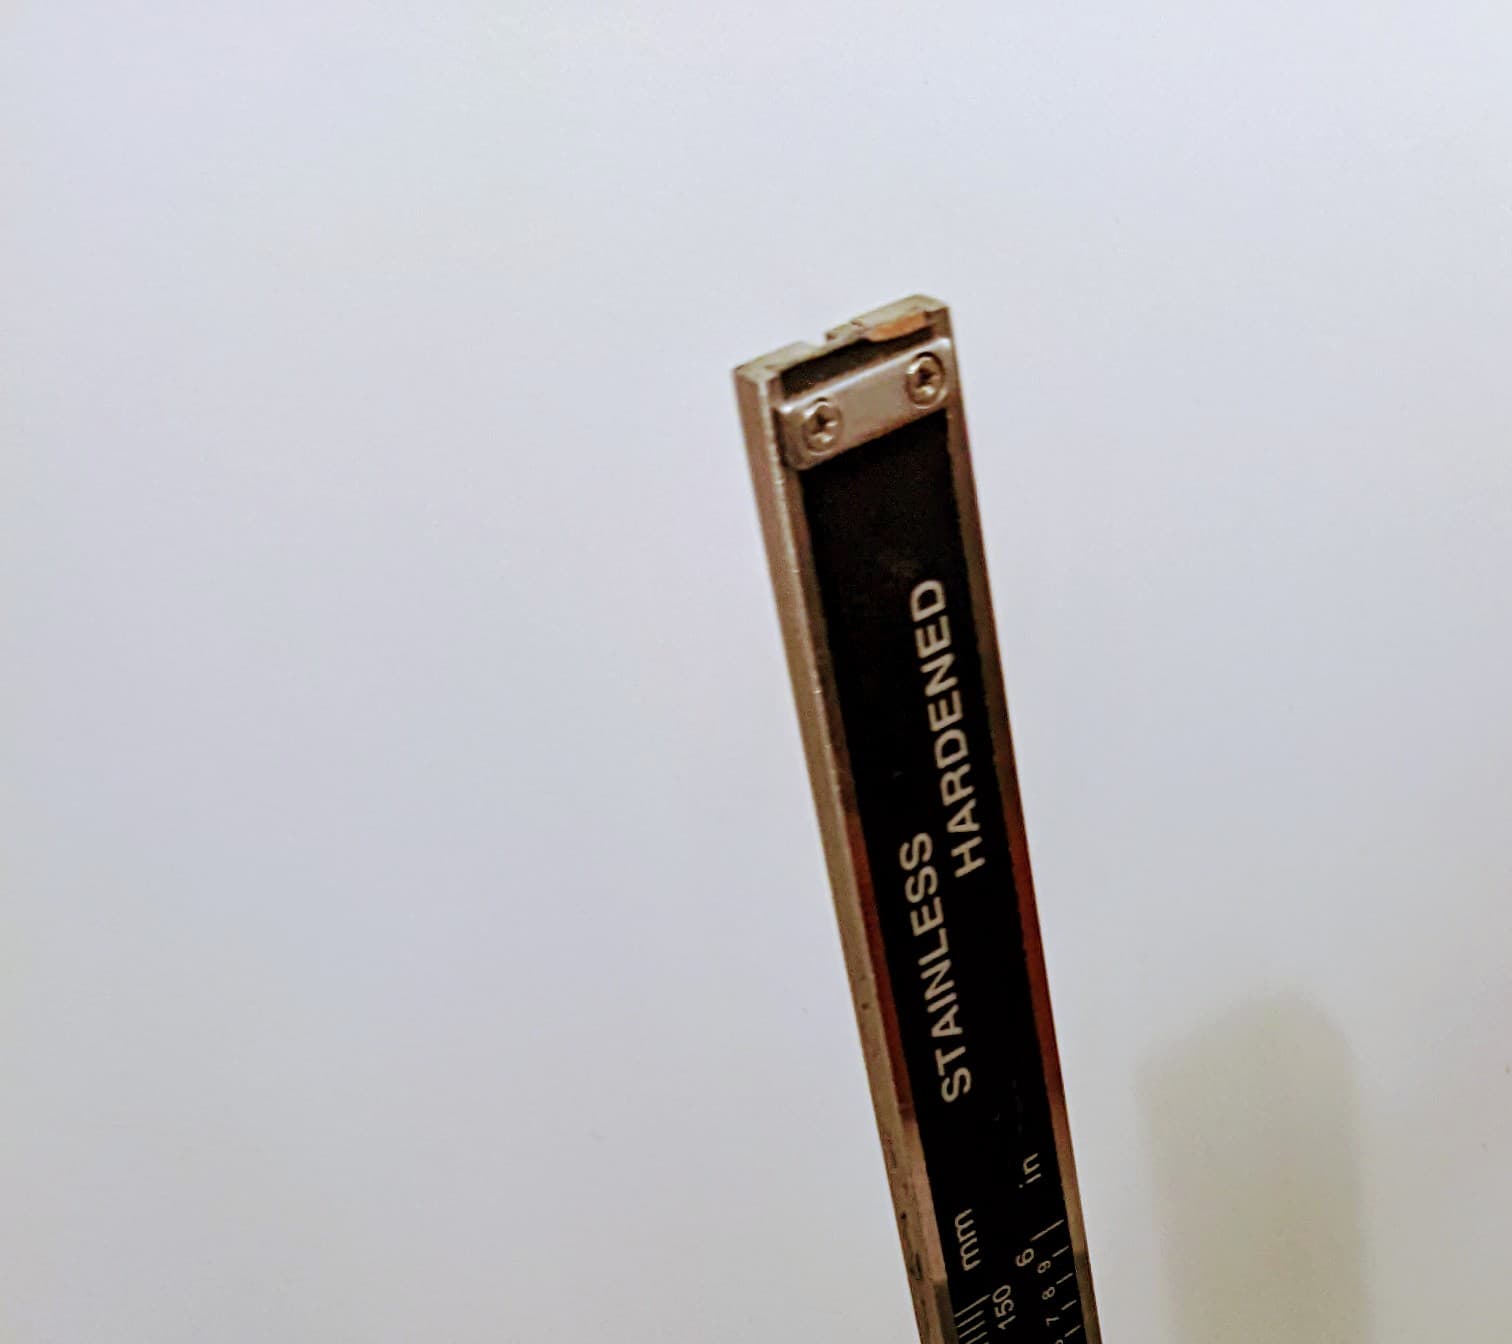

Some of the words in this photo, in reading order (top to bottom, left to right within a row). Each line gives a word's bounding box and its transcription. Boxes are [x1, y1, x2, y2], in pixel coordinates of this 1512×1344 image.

[910, 578, 986, 878] HARDENED
[898, 831, 972, 1103] STAINLESS
[1019, 1153, 1042, 1188] in
[954, 1208, 981, 1271] mm
[1015, 1248, 1035, 1267] 6
[1037, 1260, 1051, 1274] 9
[992, 1284, 1016, 1330] 150
[1041, 1286, 1056, 1300] 8
[1045, 1316, 1060, 1326] 7
